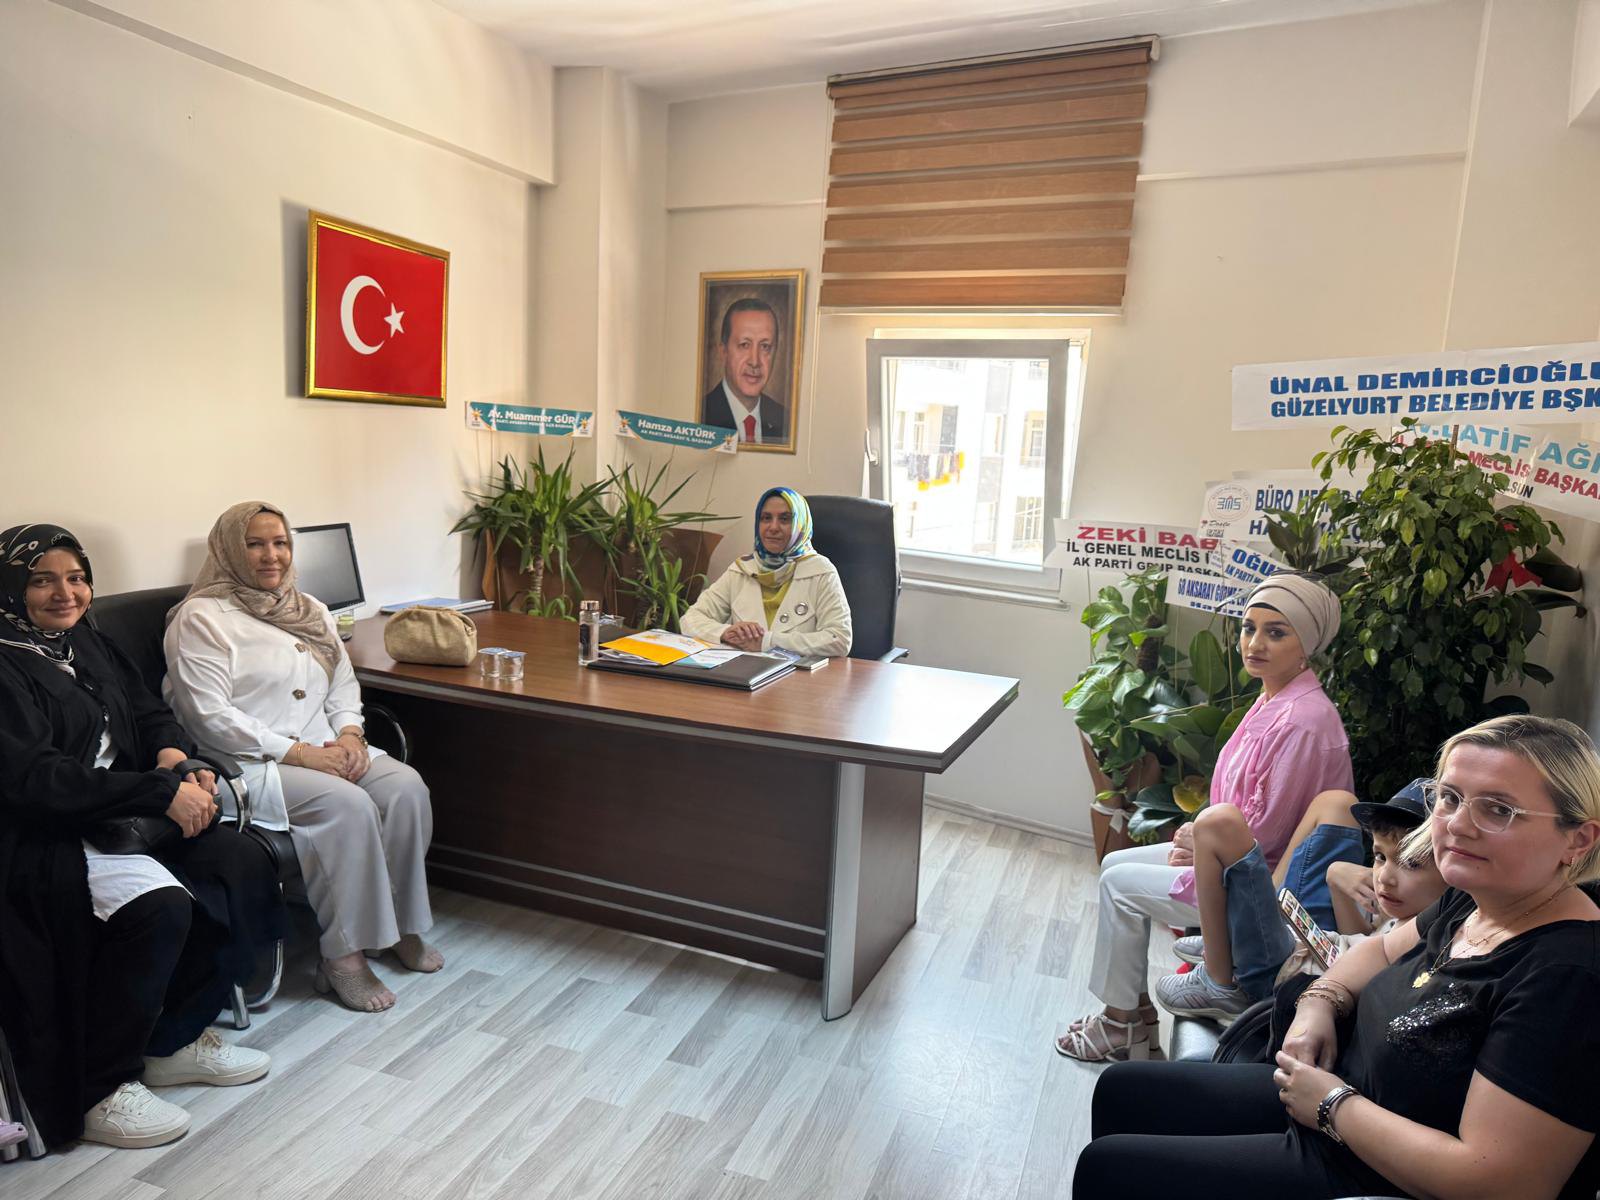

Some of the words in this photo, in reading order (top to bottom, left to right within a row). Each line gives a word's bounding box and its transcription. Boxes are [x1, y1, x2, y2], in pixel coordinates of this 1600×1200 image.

[1270, 376, 1349, 395] ÜNAL
[1271, 395, 1403, 418] GÜZELYURT
[1408, 388, 1535, 413] BELEDİYE
[505, 410, 553, 423] Muammer
[638, 419, 672, 433] Hamza
[674, 425, 716, 440] AKTÜRK
[1534, 467, 1600, 501] BAŞKA
[1255, 484, 1294, 511] BÜRO
[1077, 526, 1147, 544] ZEKİ
[1066, 539, 1080, 553] İL
[1085, 542, 1137, 557] GENEL
[1141, 546, 1200, 563] MECLİS
[1073, 557, 1091, 568] AK
[1094, 557, 1132, 570] PARTİ
[1232, 548, 1279, 577] OĞU
[1186, 579, 1216, 601] AKSARAY
